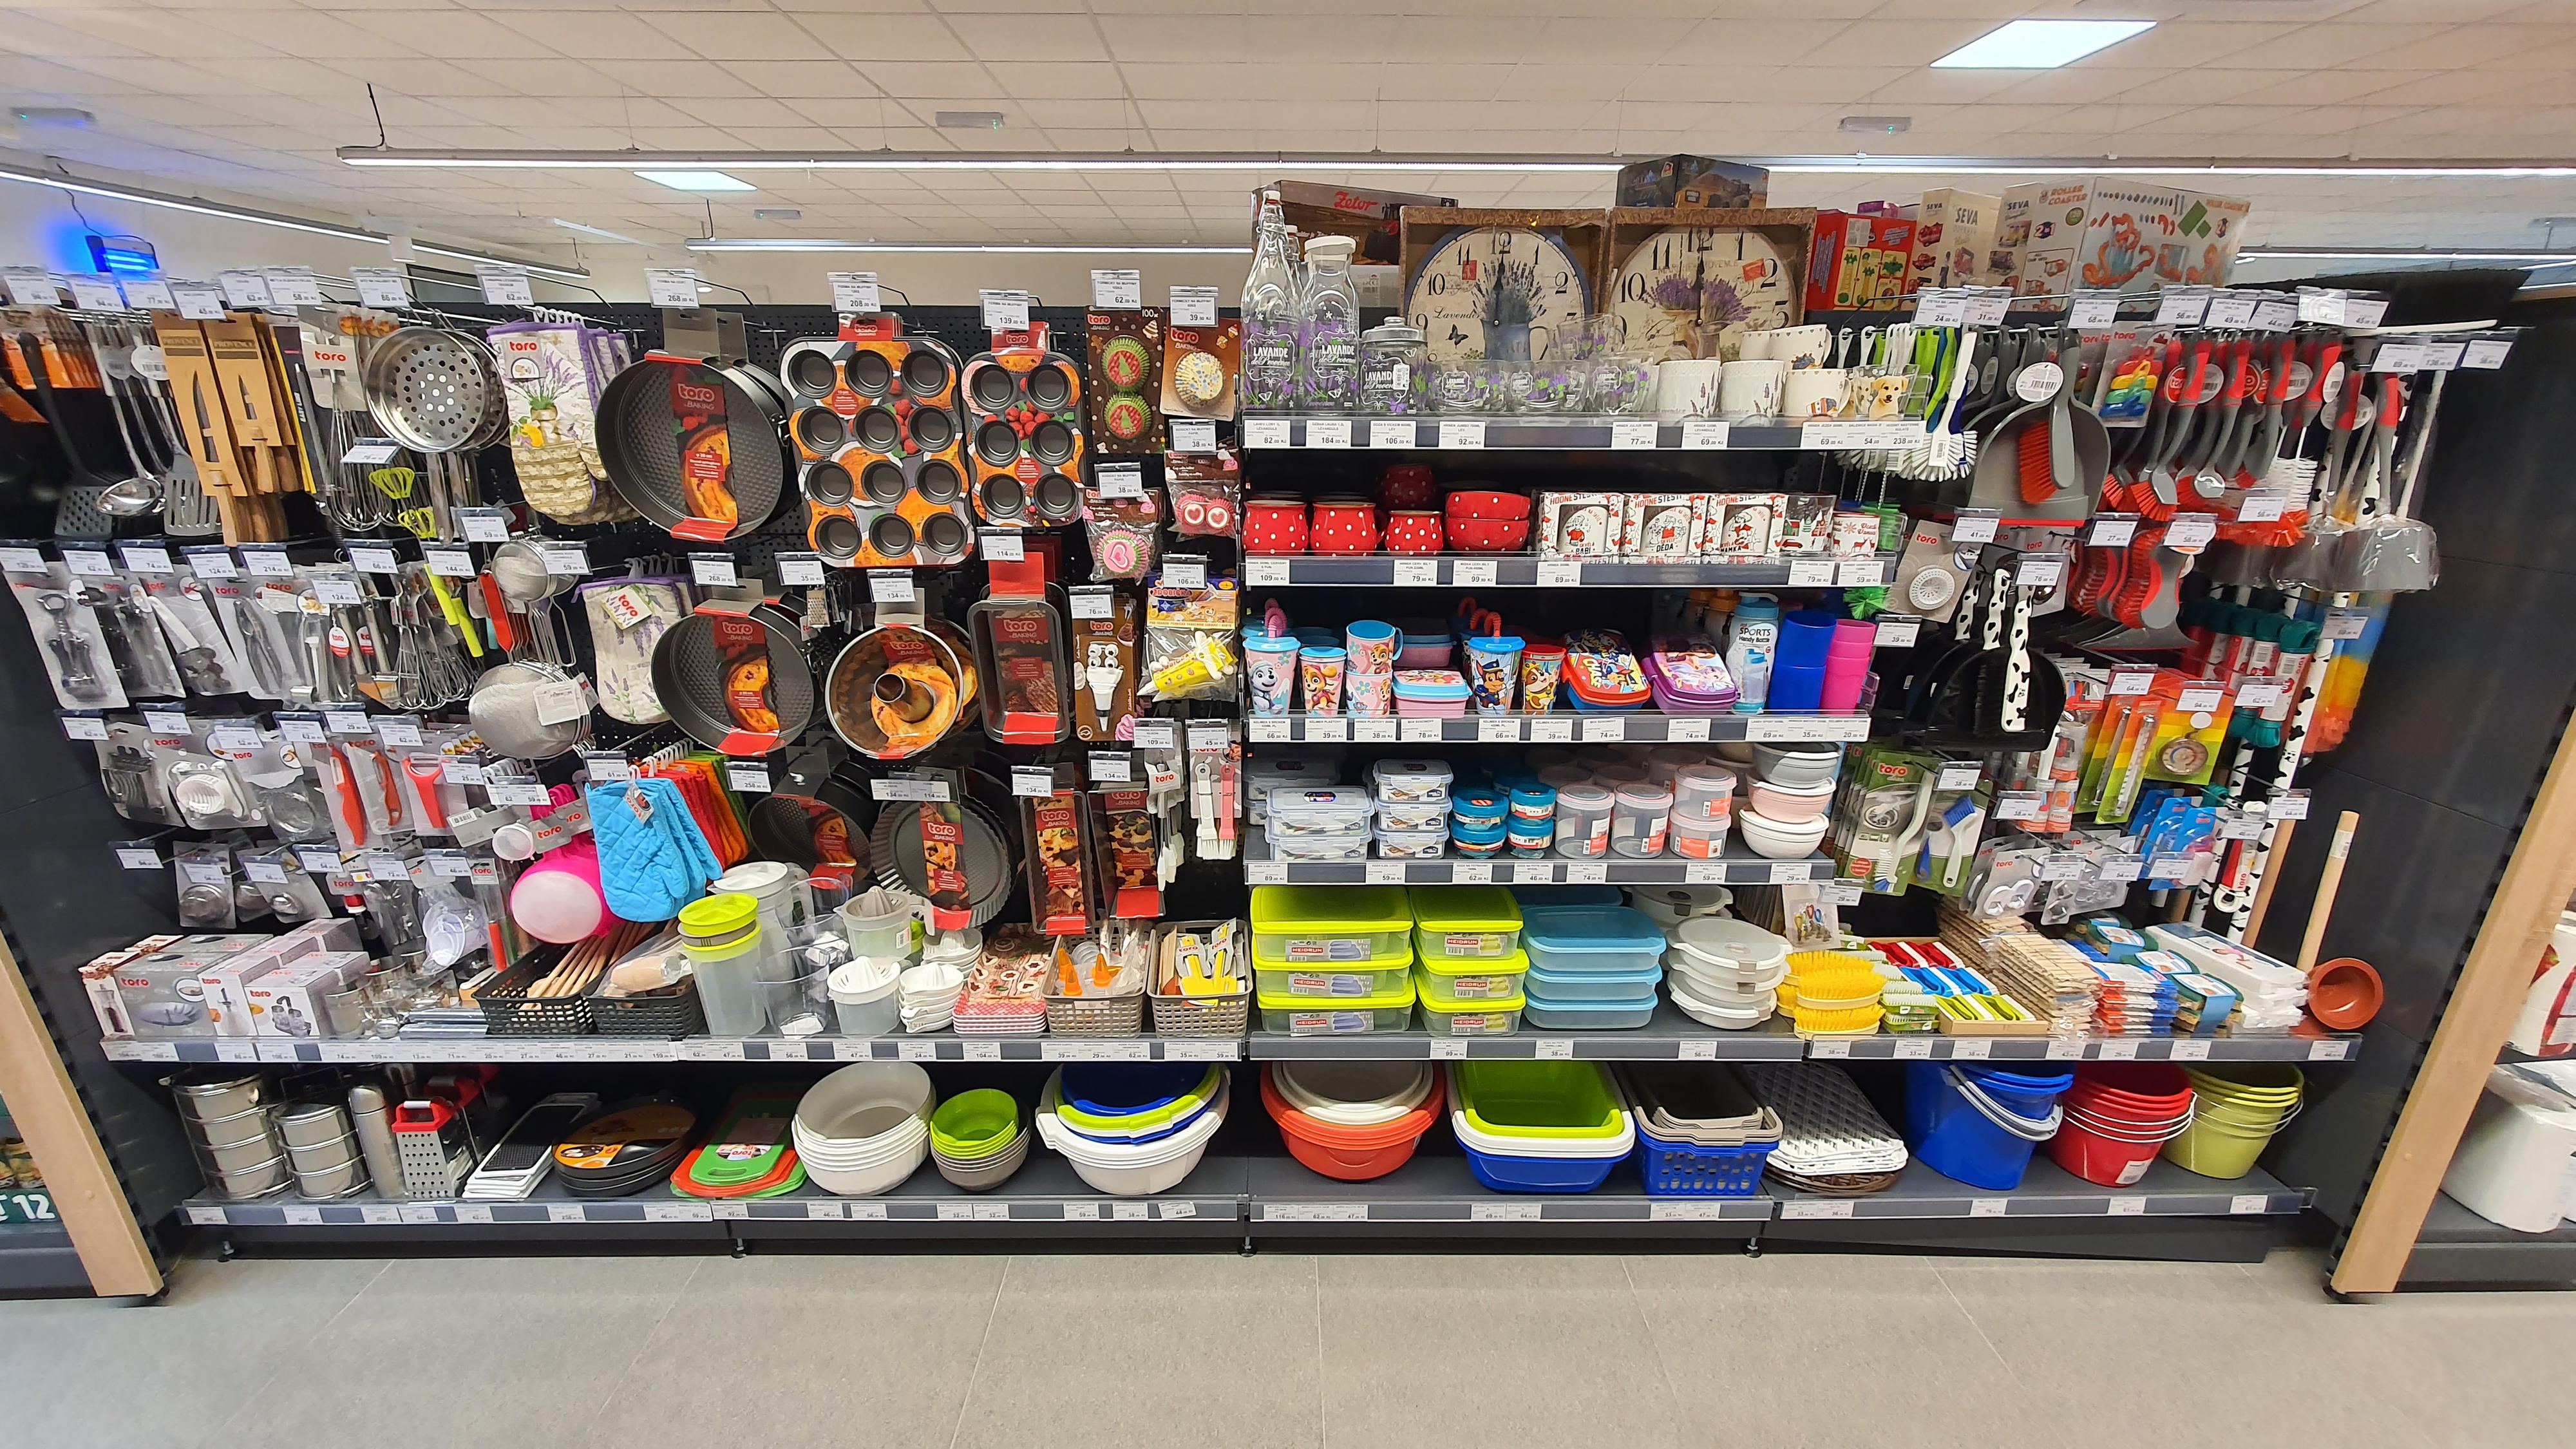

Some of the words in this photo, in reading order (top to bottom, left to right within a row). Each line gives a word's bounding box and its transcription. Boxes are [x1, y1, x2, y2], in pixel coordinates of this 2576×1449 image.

[1334, 191, 1378, 211] Zetor
[2007, 200, 2029, 210] SEVA
[1955, 207, 1978, 225] SEVA
[1427, 273, 1445, 296] 10
[1555, 272, 1569, 294] 2
[1620, 272, 1646, 303] 10
[1087, 314, 1111, 325] toro
[854, 323, 878, 333] toro
[1006, 334, 1028, 344] toro
[1171, 328, 1199, 343] toro
[509, 341, 537, 352] toro
[1253, 346, 1288, 357] LAVANDE
[1321, 345, 1354, 355] LAVANDE
[314, 350, 346, 362] toro
[1365, 371, 1392, 381] LAVAND
[677, 383, 715, 402] toro
[1917, 533, 1937, 545] toro
[2027, 541, 2043, 551] toro
[215, 586, 240, 594] toro
[265, 582, 293, 591] toro
[618, 594, 638, 617] toro
[721, 621, 753, 635] toro
[1003, 620, 1037, 632] toro
[1090, 621, 1113, 630] toro
[1739, 627, 1771, 636] SPORTS
[889, 639, 925, 650] toro
[233, 751, 252, 759] toro
[1878, 762, 1908, 776] toro
[1155, 773, 1175, 784] toro
[625, 797, 641, 819] toro
[1041, 811, 1070, 821] toro
[537, 826, 562, 839] toro
[927, 822, 956, 836] toro
[1211, 938, 1227, 949] toro
[12, 1194, 55, 1219] 12
